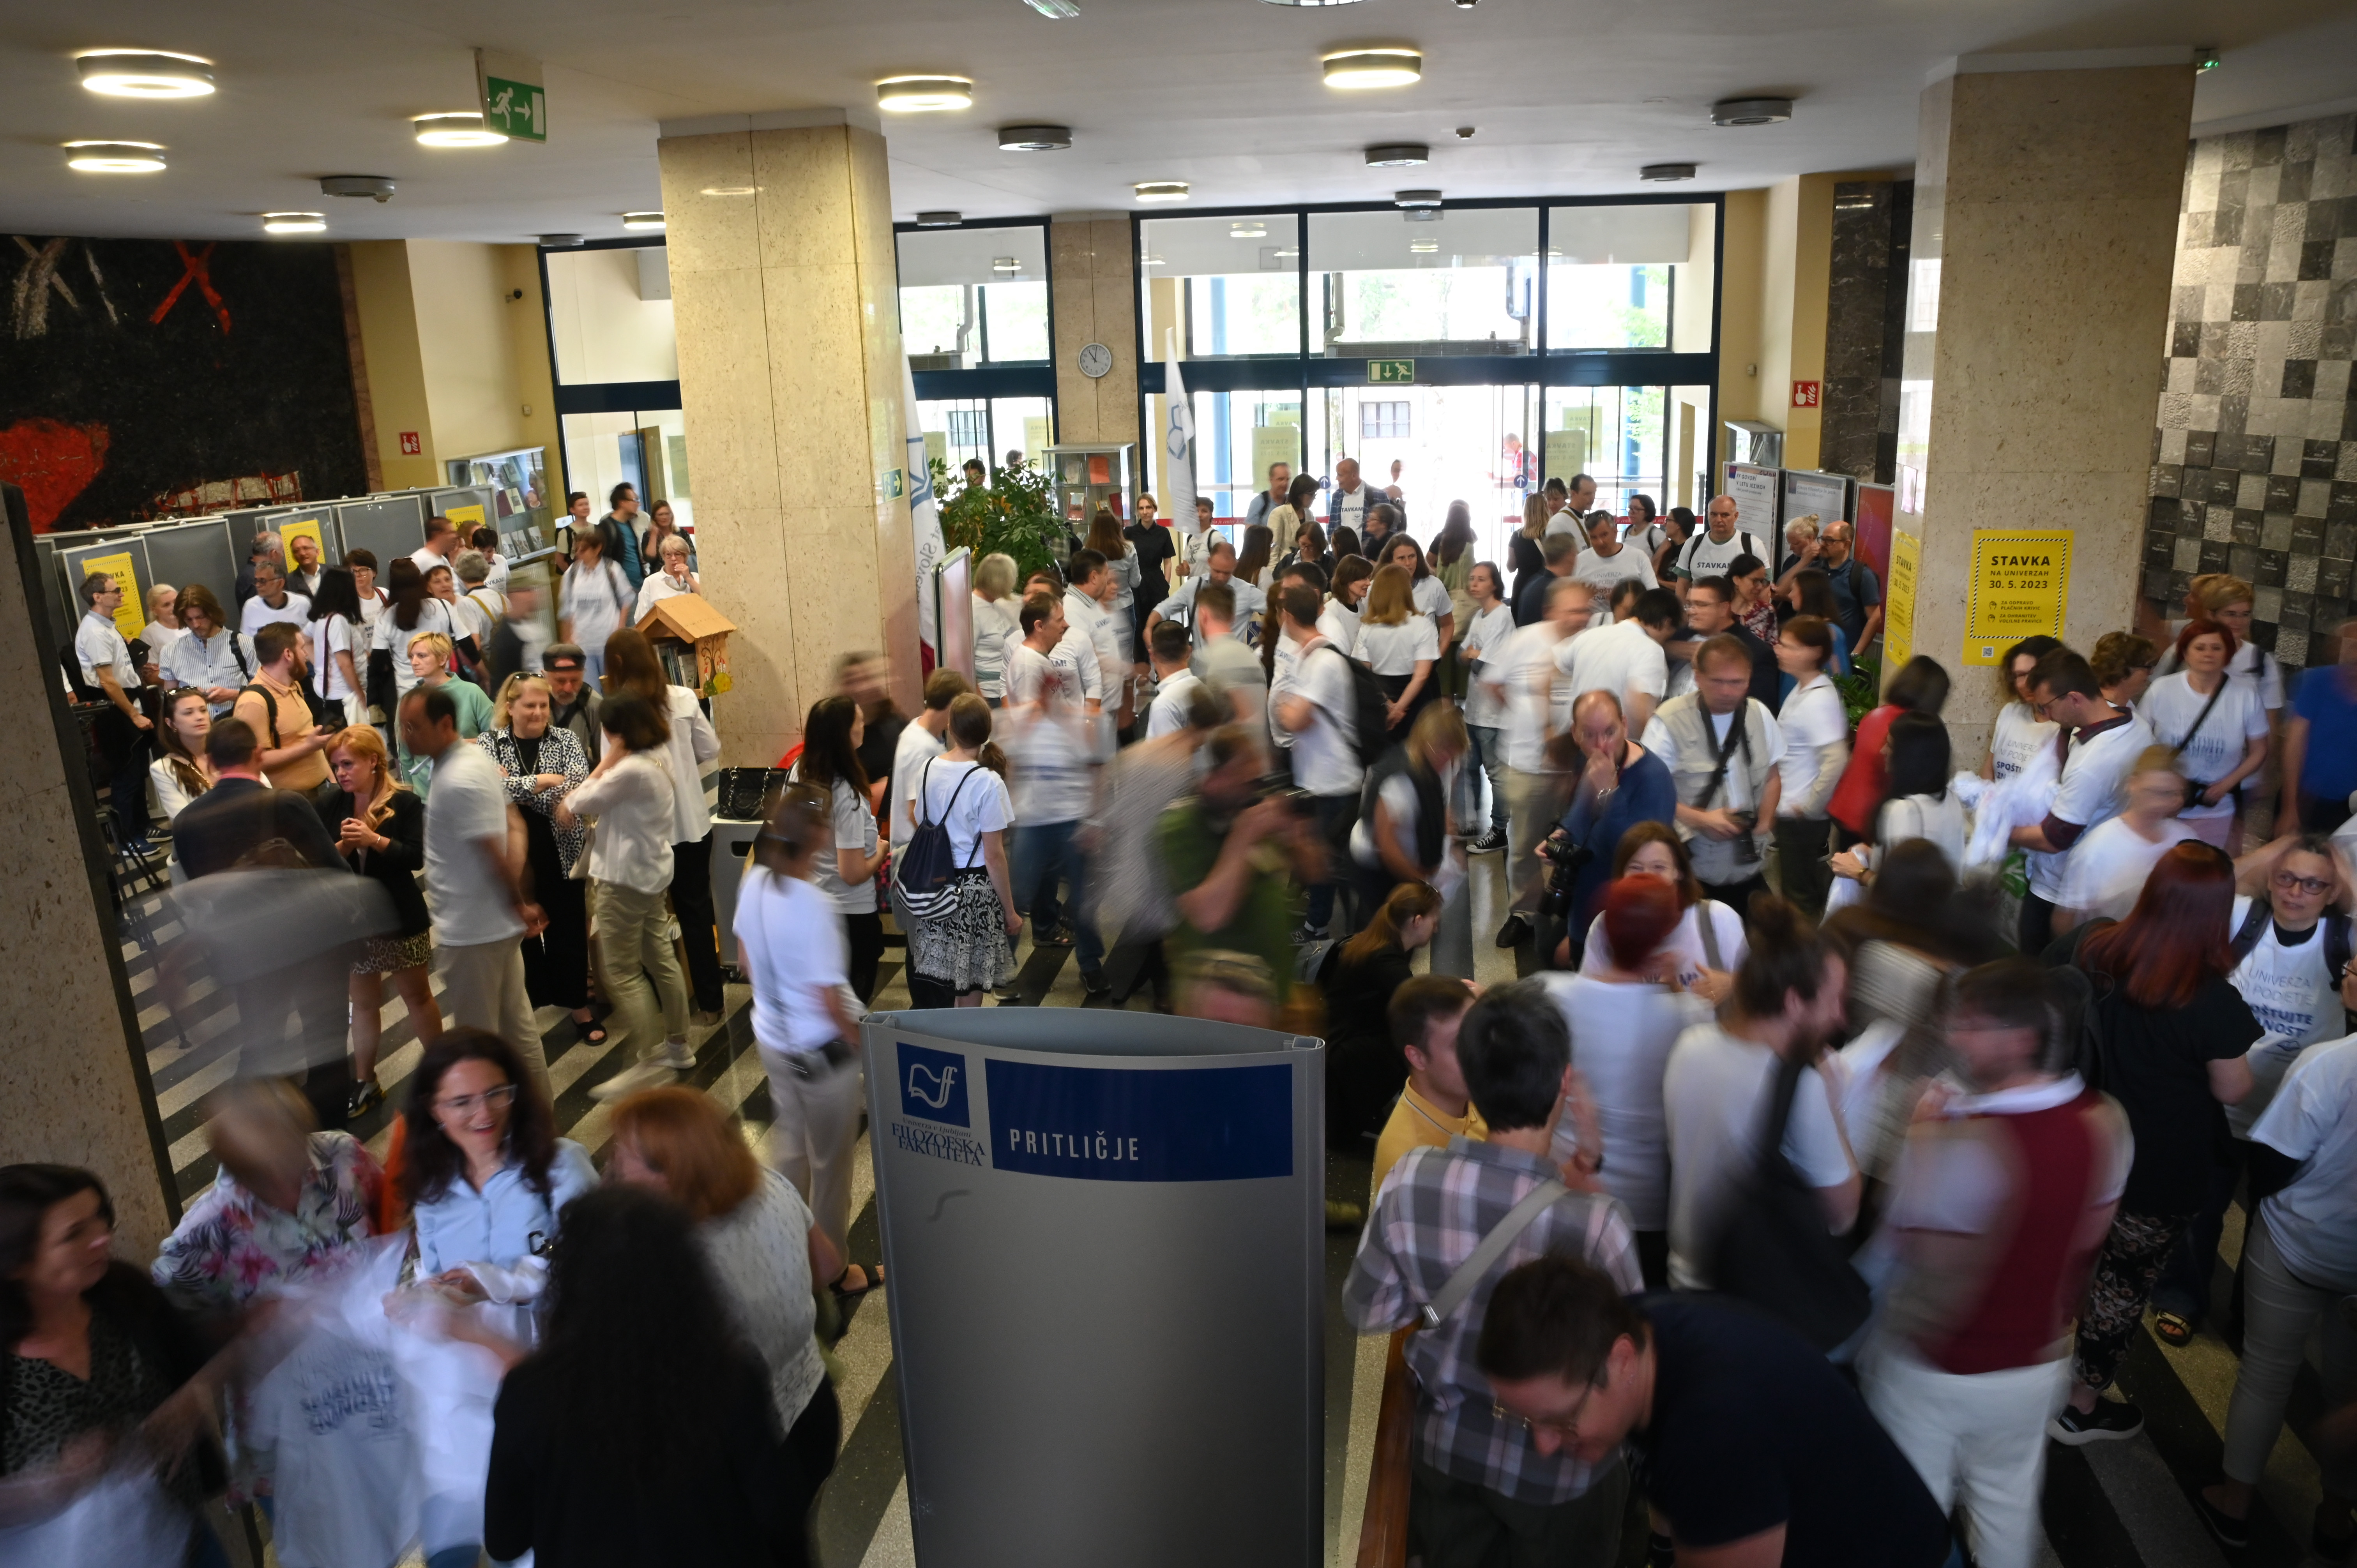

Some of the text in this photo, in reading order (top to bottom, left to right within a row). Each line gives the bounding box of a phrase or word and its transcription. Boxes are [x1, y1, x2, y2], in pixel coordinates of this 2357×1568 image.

[1896, 555, 1912, 572] STAVKA
[1991, 556, 2050, 566] STAVKA
[1989, 580, 2004, 588] 30.
[2008, 580, 2016, 588] 5.
[2007, 740, 2037, 752] UNIVERZ
[2007, 750, 2034, 762] PODJET
[1997, 761, 2025, 773] SPOŠTU
[2249, 968, 2311, 988] UNIVERZA
[2251, 1004, 2314, 1025] OŠTUJTE
[903, 1117, 932, 1129] Univerza
[939, 1126, 971, 1138] Ljubljani
[898, 1135, 982, 1167] FAKULTETA
[1010, 1128, 1139, 1160] PRITLIČJE
